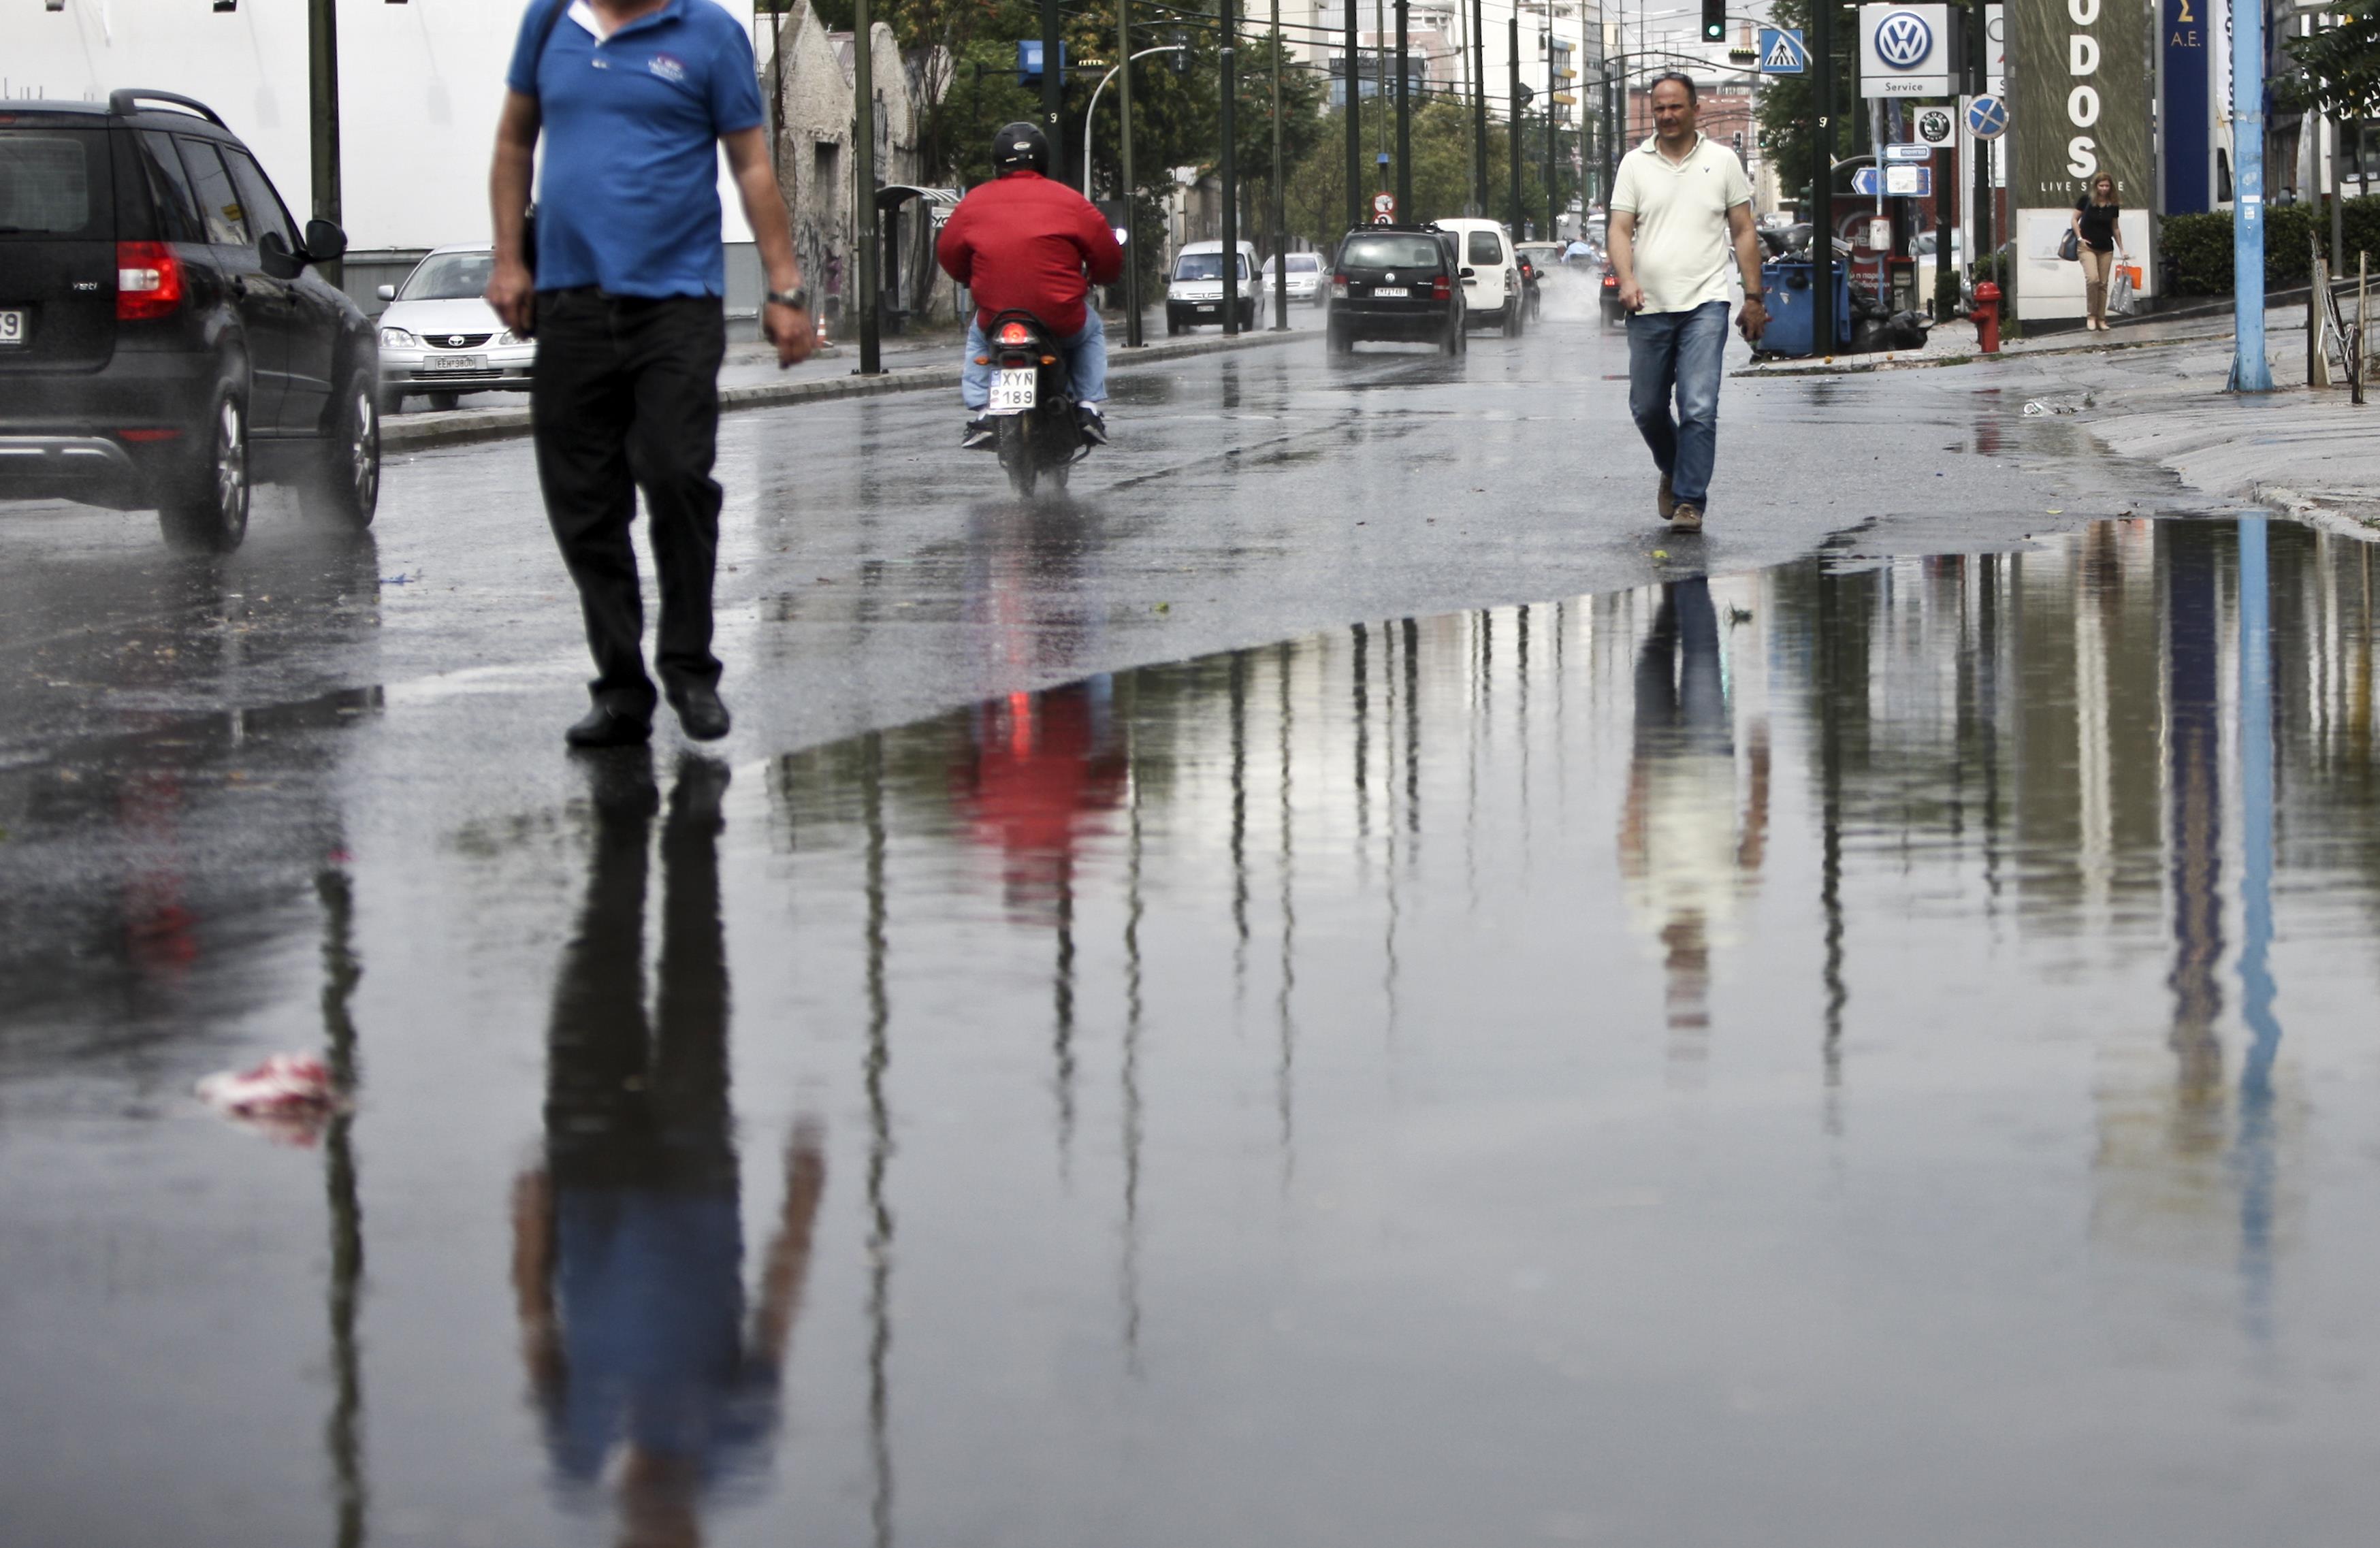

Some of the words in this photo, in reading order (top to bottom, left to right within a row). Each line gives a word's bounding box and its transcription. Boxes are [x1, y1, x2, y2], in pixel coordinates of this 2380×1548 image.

[1885, 82, 1923, 92] Service
[1050, 112, 1057, 123] 9
[1819, 116, 1827, 128] 9
[2041, 182, 2071, 191] LIVE
[0, 313, 18, 336] 9
[1003, 372, 1033, 386] XYN
[1003, 391, 1033, 404] 189
